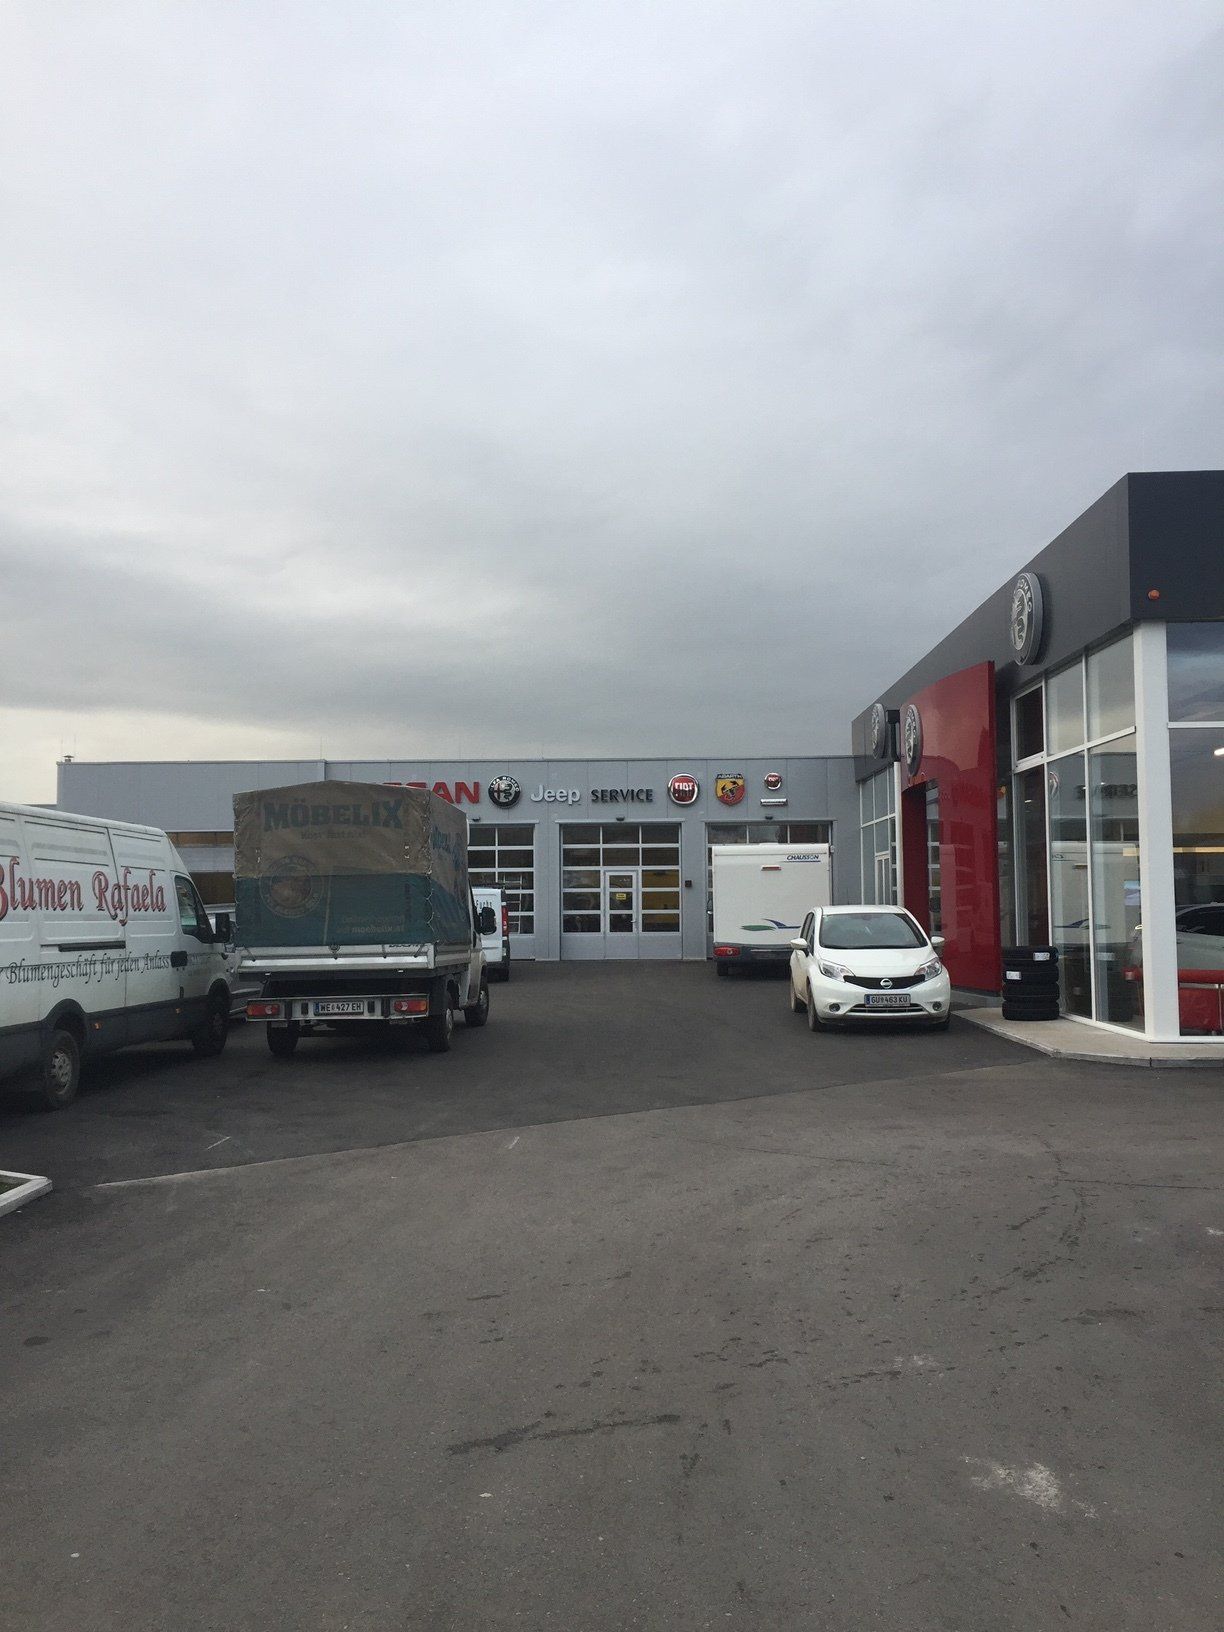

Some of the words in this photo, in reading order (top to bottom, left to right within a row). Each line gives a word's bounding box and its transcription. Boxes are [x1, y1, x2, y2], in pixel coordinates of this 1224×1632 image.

[530, 784, 581, 806] Jeep
[590, 788, 654, 803] SERVICE
[674, 782, 694, 791] FIAT
[263, 797, 403, 832] MÖBELIX
[92, 866, 167, 926] Rafaela
[7, 953, 97, 988] Blumengeschäft
[97, 952, 116, 983] für
[114, 951, 140, 981] jeden
[140, 949, 170, 974] Anlass
